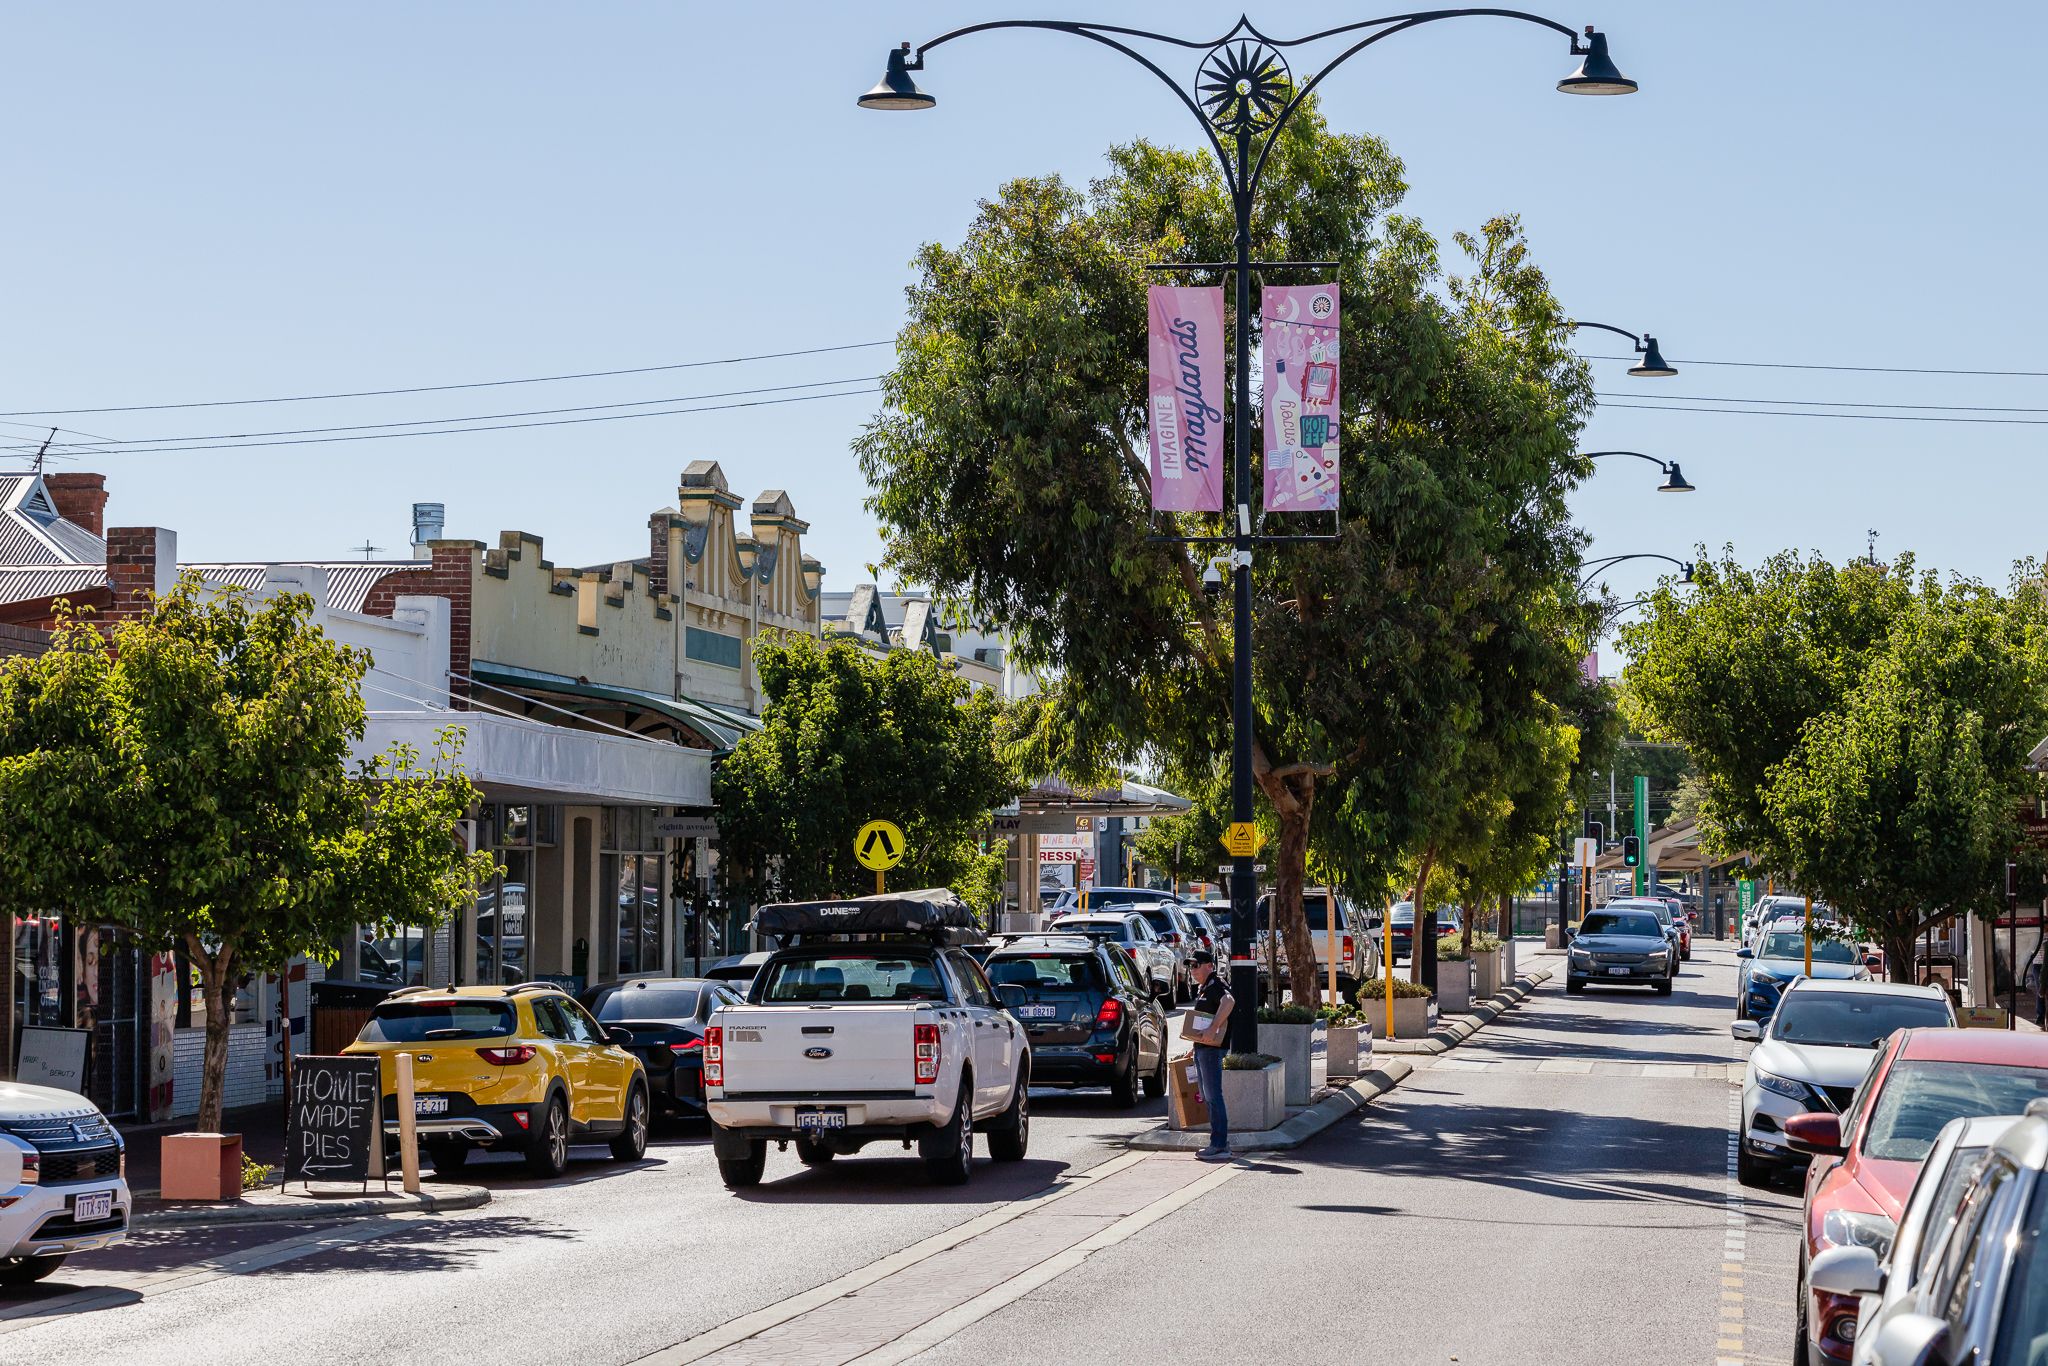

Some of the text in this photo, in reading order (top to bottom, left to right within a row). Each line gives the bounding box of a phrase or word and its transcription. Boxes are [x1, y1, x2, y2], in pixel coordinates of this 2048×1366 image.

[1169, 317, 1222, 472] maylands
[1157, 401, 1179, 471] IMAGINE
[658, 823, 684, 831] eighth
[994, 819, 1020, 830] PLAY
[820, 907, 848, 916] DUNE
[808, 1048, 826, 1057] Ford
[48, 1069, 76, 1078] BEAUTY
[296, 1069, 373, 1104] HOME
[300, 1104, 365, 1129] MADE
[302, 1130, 350, 1159] PIES
